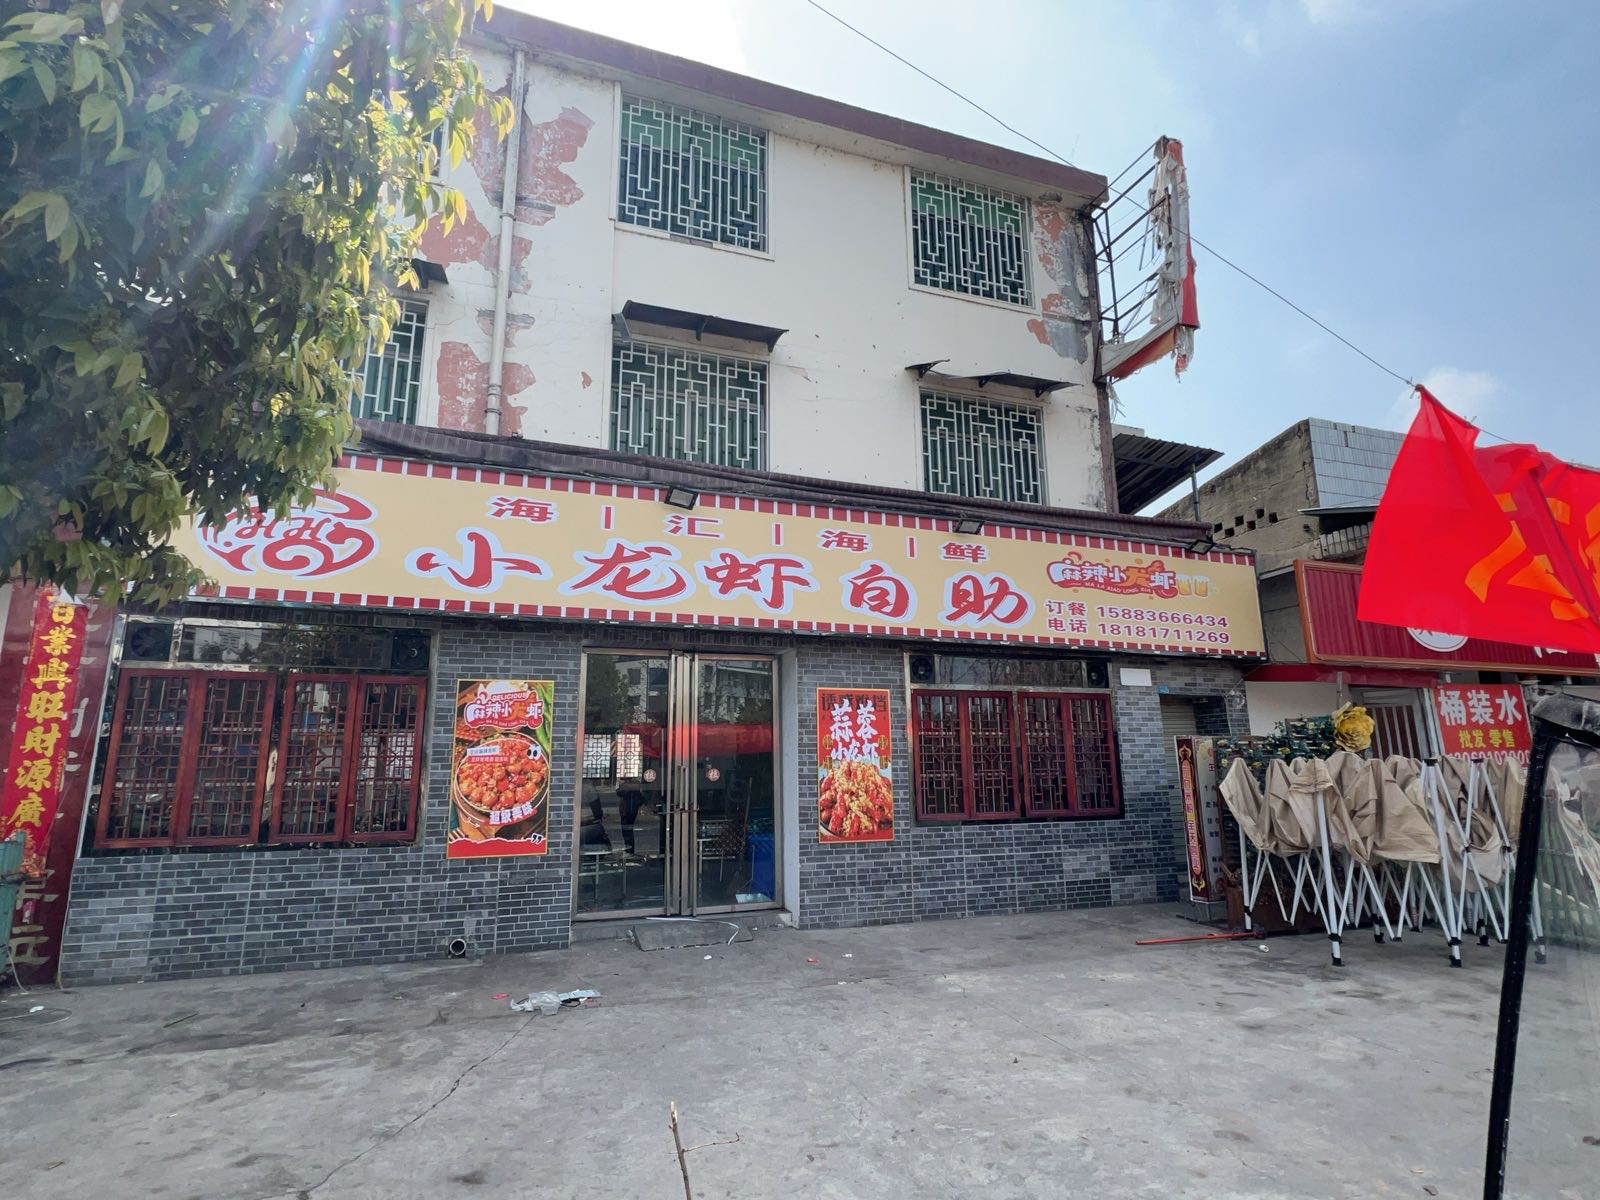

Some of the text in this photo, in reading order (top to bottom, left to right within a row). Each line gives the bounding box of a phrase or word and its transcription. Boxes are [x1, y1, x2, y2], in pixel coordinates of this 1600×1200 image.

[416, 531, 1028, 624] 小龙虾自助
[1046, 600, 1228, 628] 订餐 15883666434
[1048, 618, 1230, 643] 电话 18181711269
[1438, 689, 1523, 726] 桶装水
[1458, 728, 1516, 749] 批发 零售
